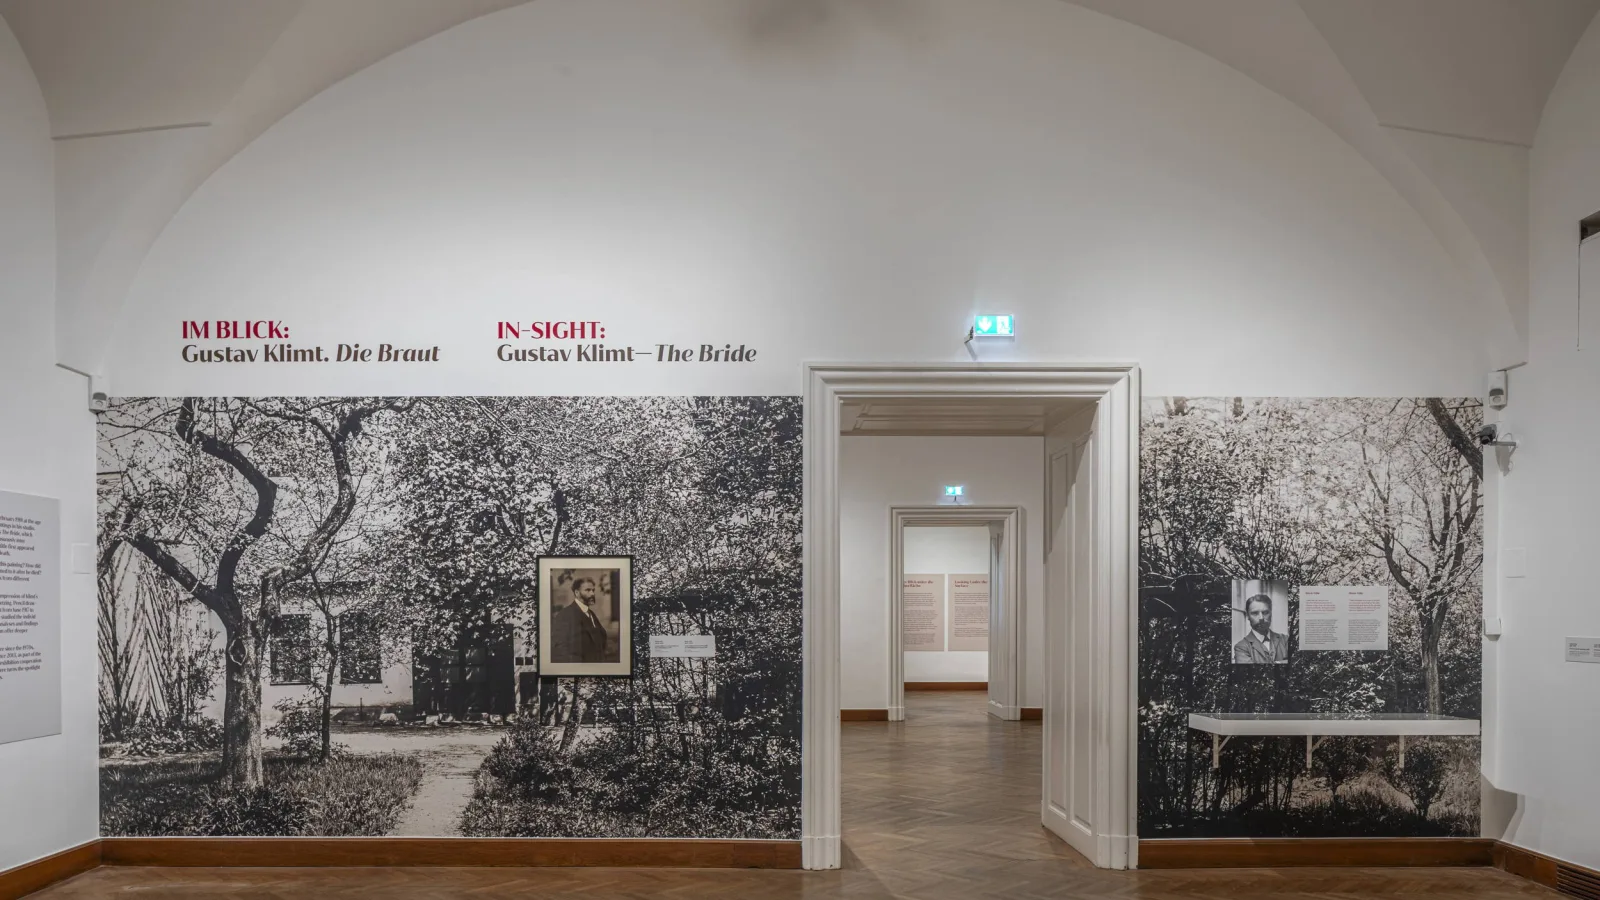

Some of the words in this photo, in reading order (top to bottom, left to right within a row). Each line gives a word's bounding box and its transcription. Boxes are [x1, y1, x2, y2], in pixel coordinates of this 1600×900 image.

[182, 321, 210, 340] IM
[216, 321, 290, 340] BLICK:
[497, 321, 606, 340] IN-SIGHT:
[181, 344, 259, 363] Gustav
[263, 343, 330, 363] Klimt.
[335, 343, 373, 363] Die
[377, 343, 441, 363] Braut
[496, 344, 572, 363] Gustav
[698, 343, 757, 363] Bride
